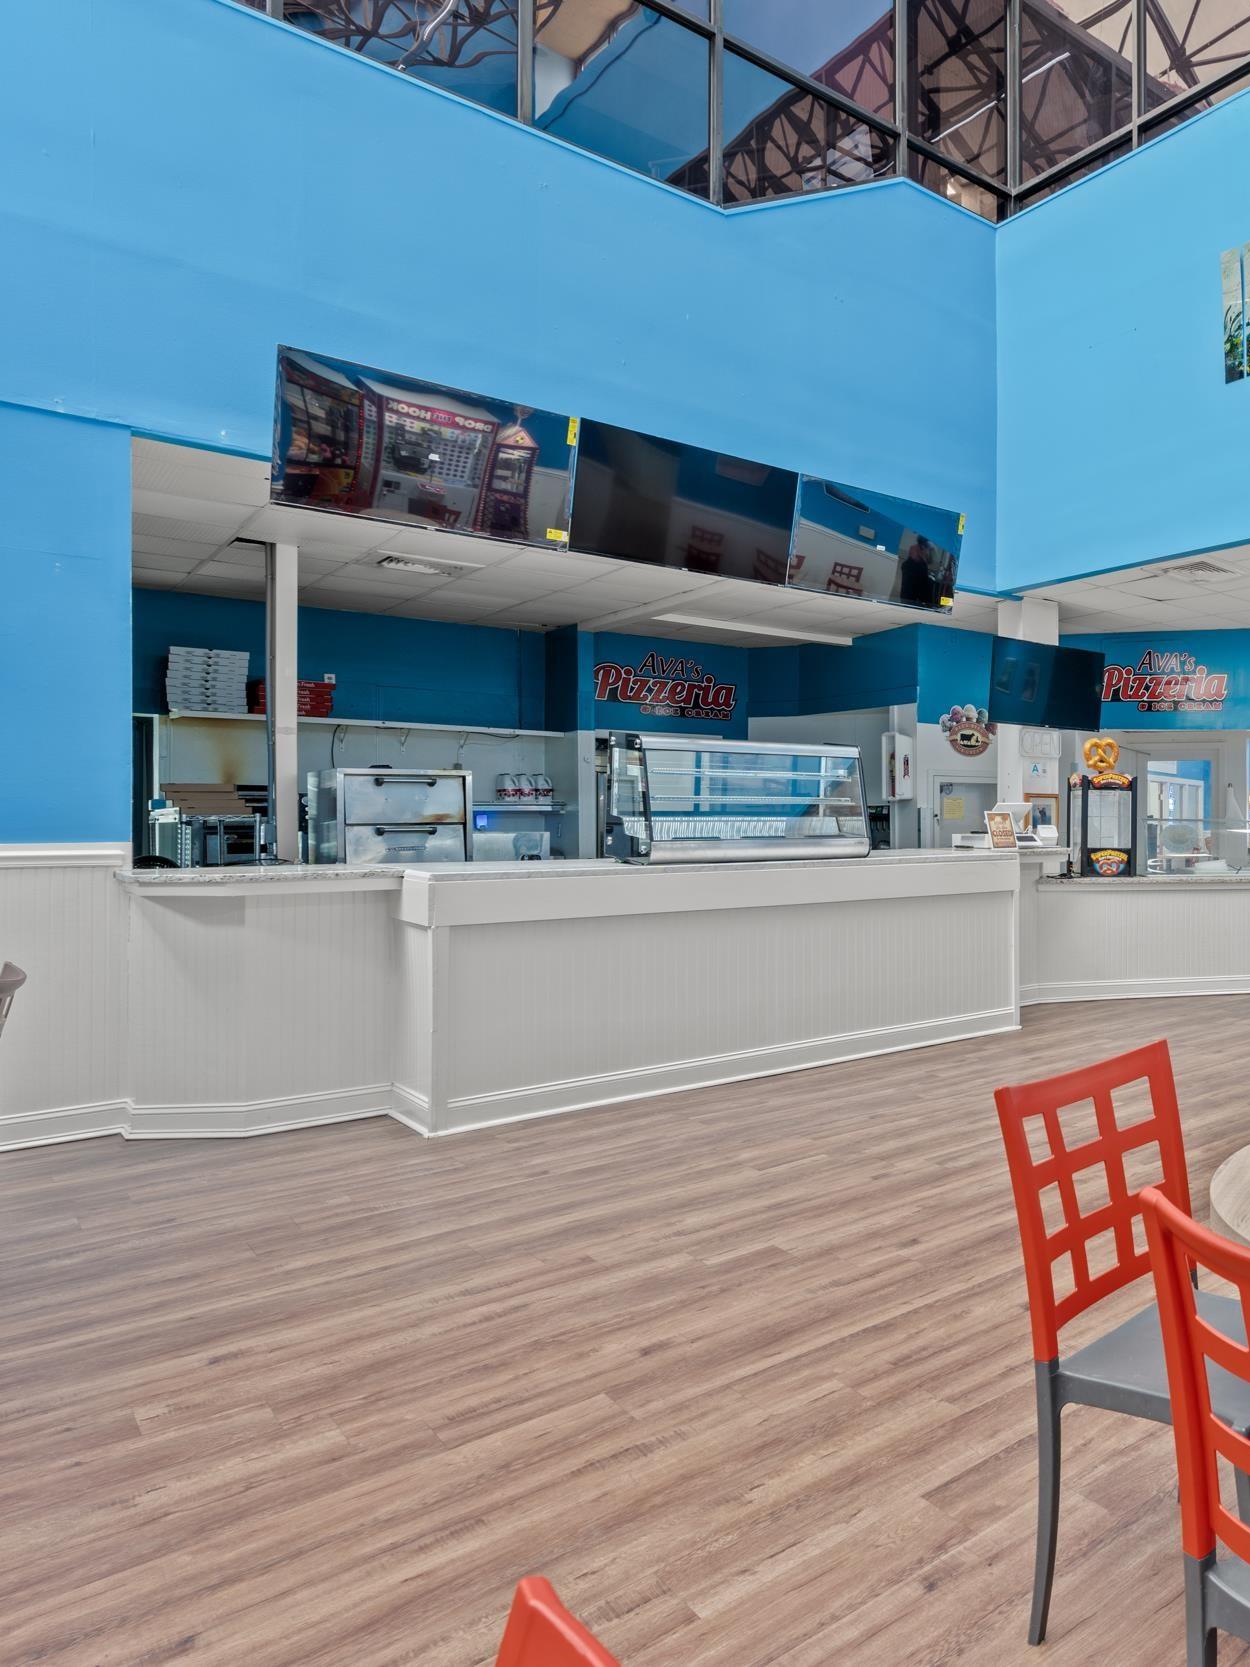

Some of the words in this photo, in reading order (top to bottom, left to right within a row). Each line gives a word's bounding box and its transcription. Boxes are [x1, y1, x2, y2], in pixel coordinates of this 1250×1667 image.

[593, 662, 736, 710] Pizzeria
[1102, 665, 1228, 702] Pizzeria
[1151, 701, 1174, 711] ICE
[1178, 701, 1223, 711] CREAM
[1032, 764, 1039, 773] A
